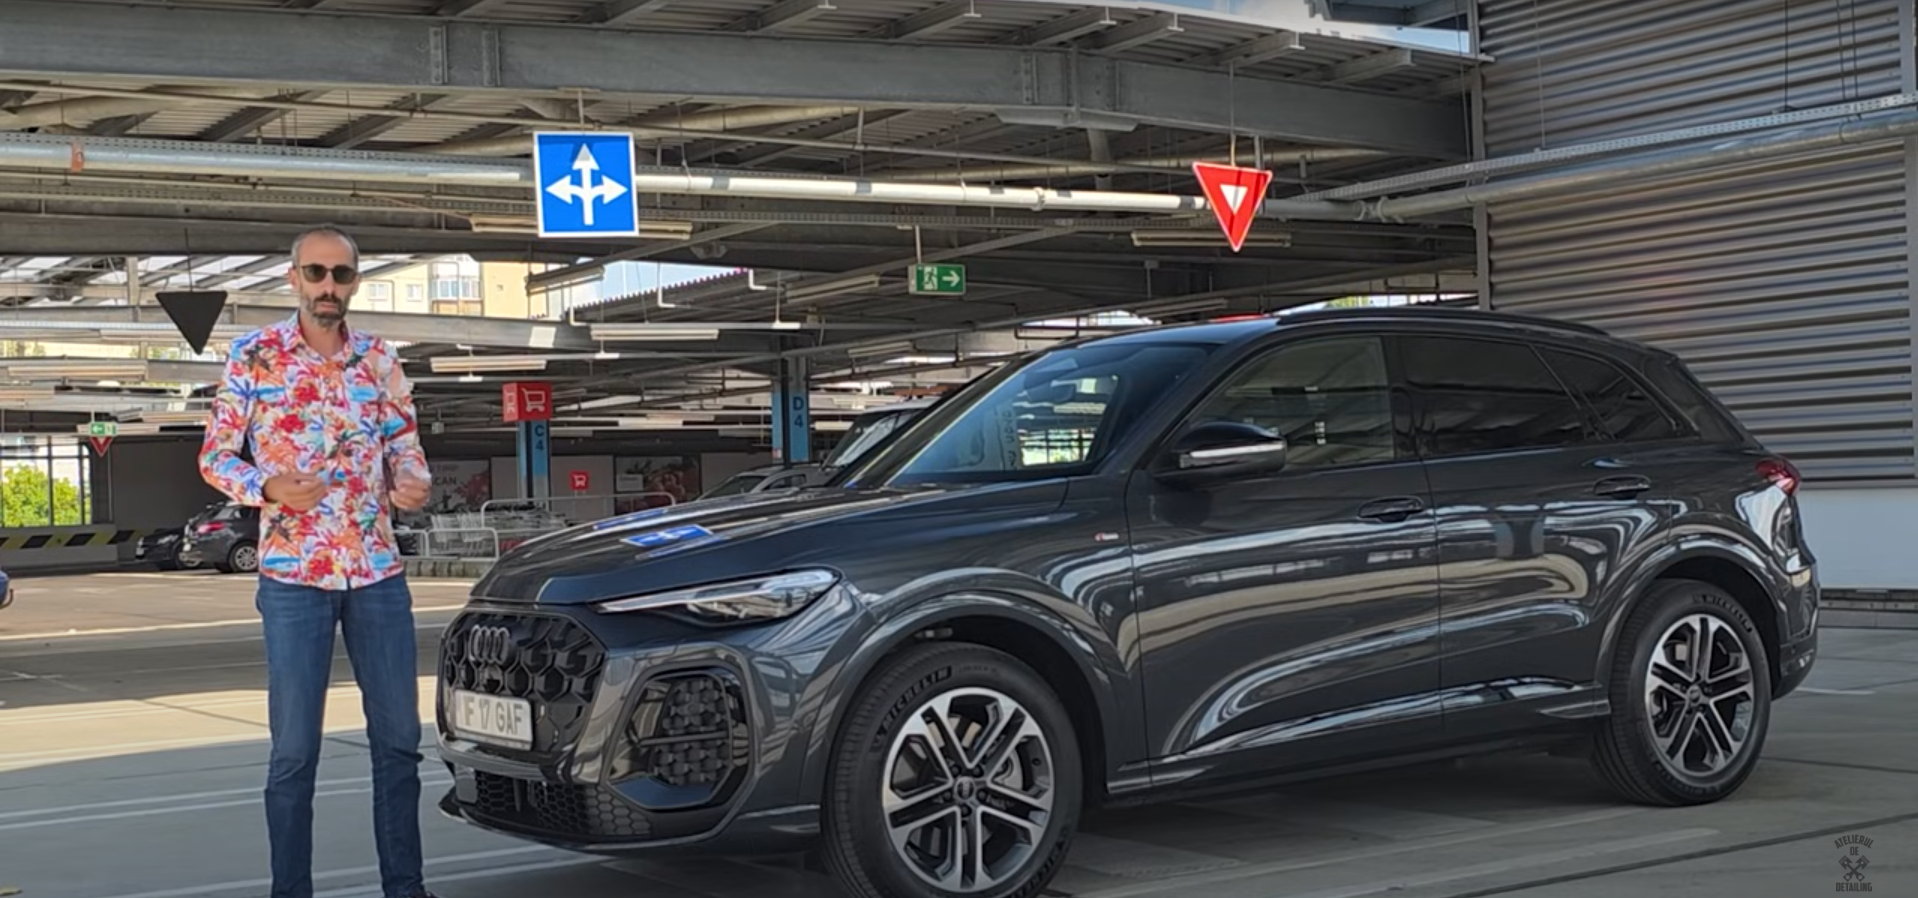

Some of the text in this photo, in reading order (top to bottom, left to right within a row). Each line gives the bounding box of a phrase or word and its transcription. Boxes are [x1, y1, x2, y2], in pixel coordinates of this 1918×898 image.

[793, 396, 805, 411] D
[794, 414, 804, 428] 4
[534, 424, 545, 437] C
[535, 440, 545, 451] 4
[432, 476, 457, 486] CAN
[878, 665, 951, 732] MICHELIN
[495, 700, 523, 736] GAF
